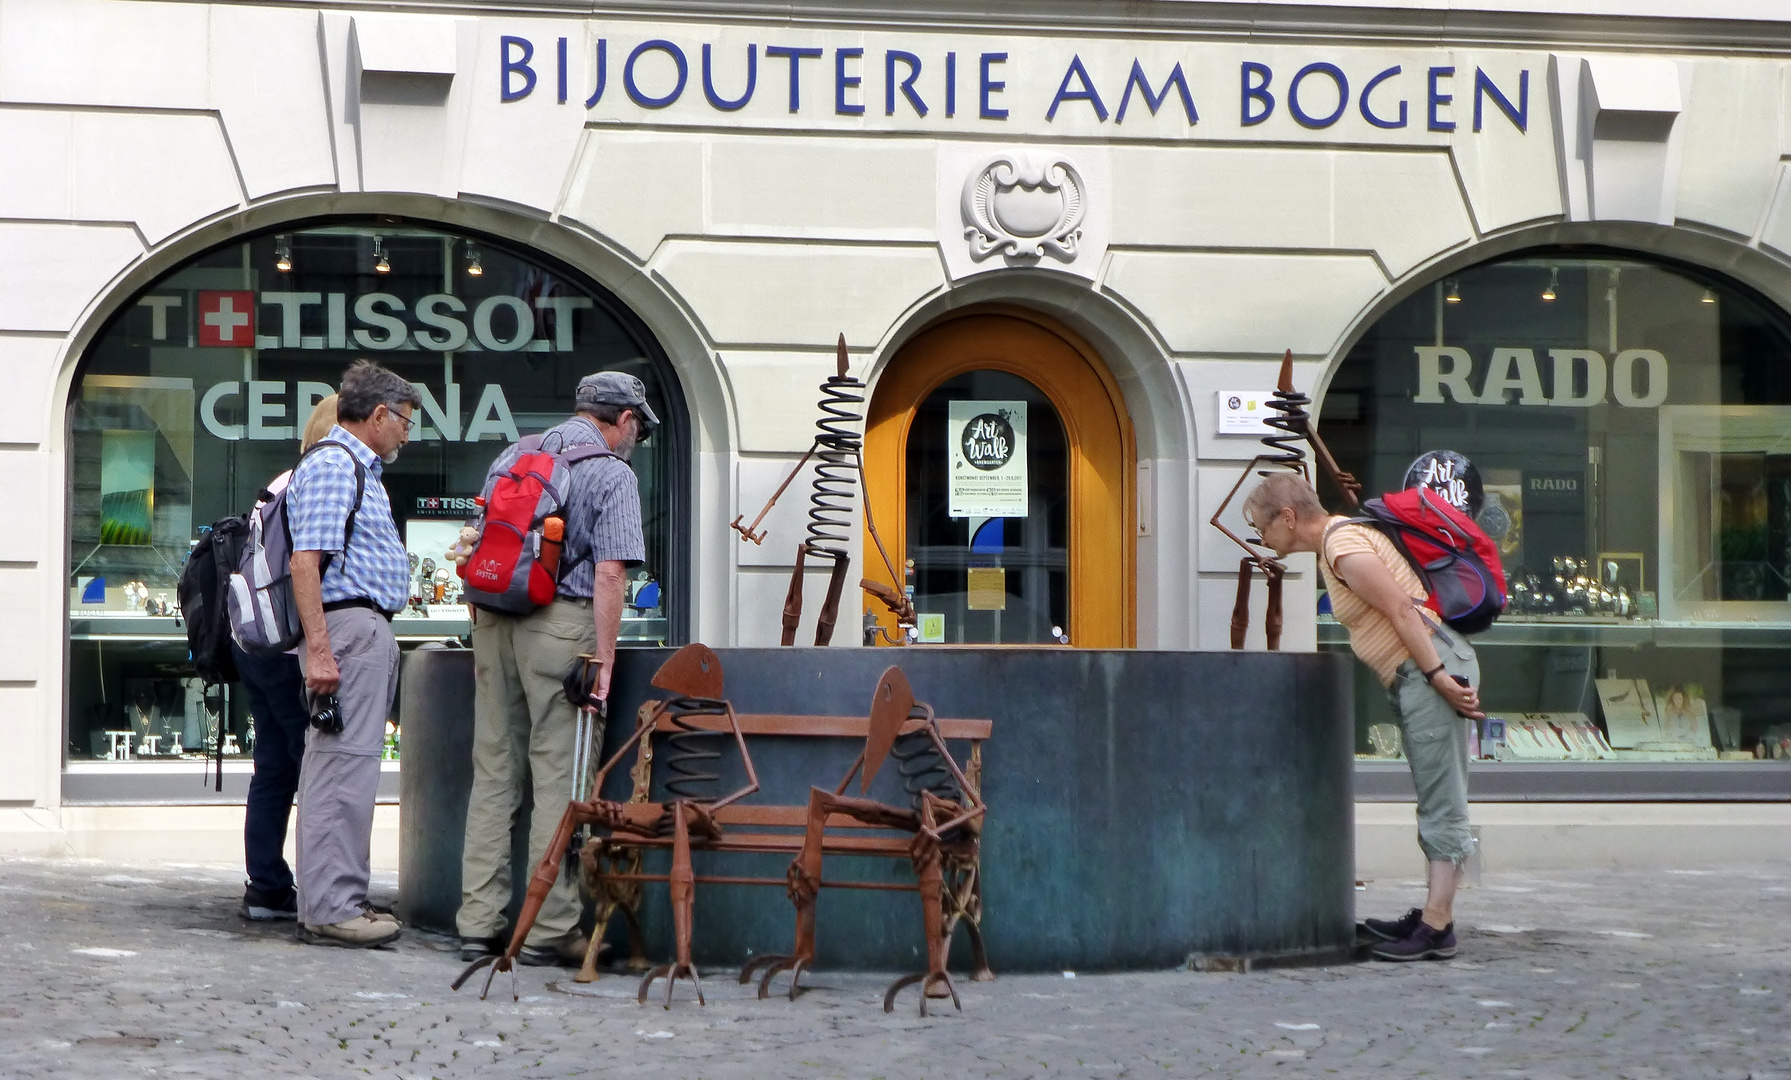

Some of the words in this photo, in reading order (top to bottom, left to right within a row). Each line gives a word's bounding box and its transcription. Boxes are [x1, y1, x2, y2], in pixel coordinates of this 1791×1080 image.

[500, 35, 1010, 119] BIJOUTERIE
[1045, 53, 1201, 126] AM
[1241, 61, 1530, 134] BOGEN
[261, 291, 594, 352] TISSOT
[1413, 345, 1669, 409] RADO
[972, 418, 999, 440] Art
[965, 436, 1009, 460] Walk
[1423, 458, 1455, 484] Art
[1530, 478, 1577, 491] RADO
[475, 569, 499, 581] SYSTEM
